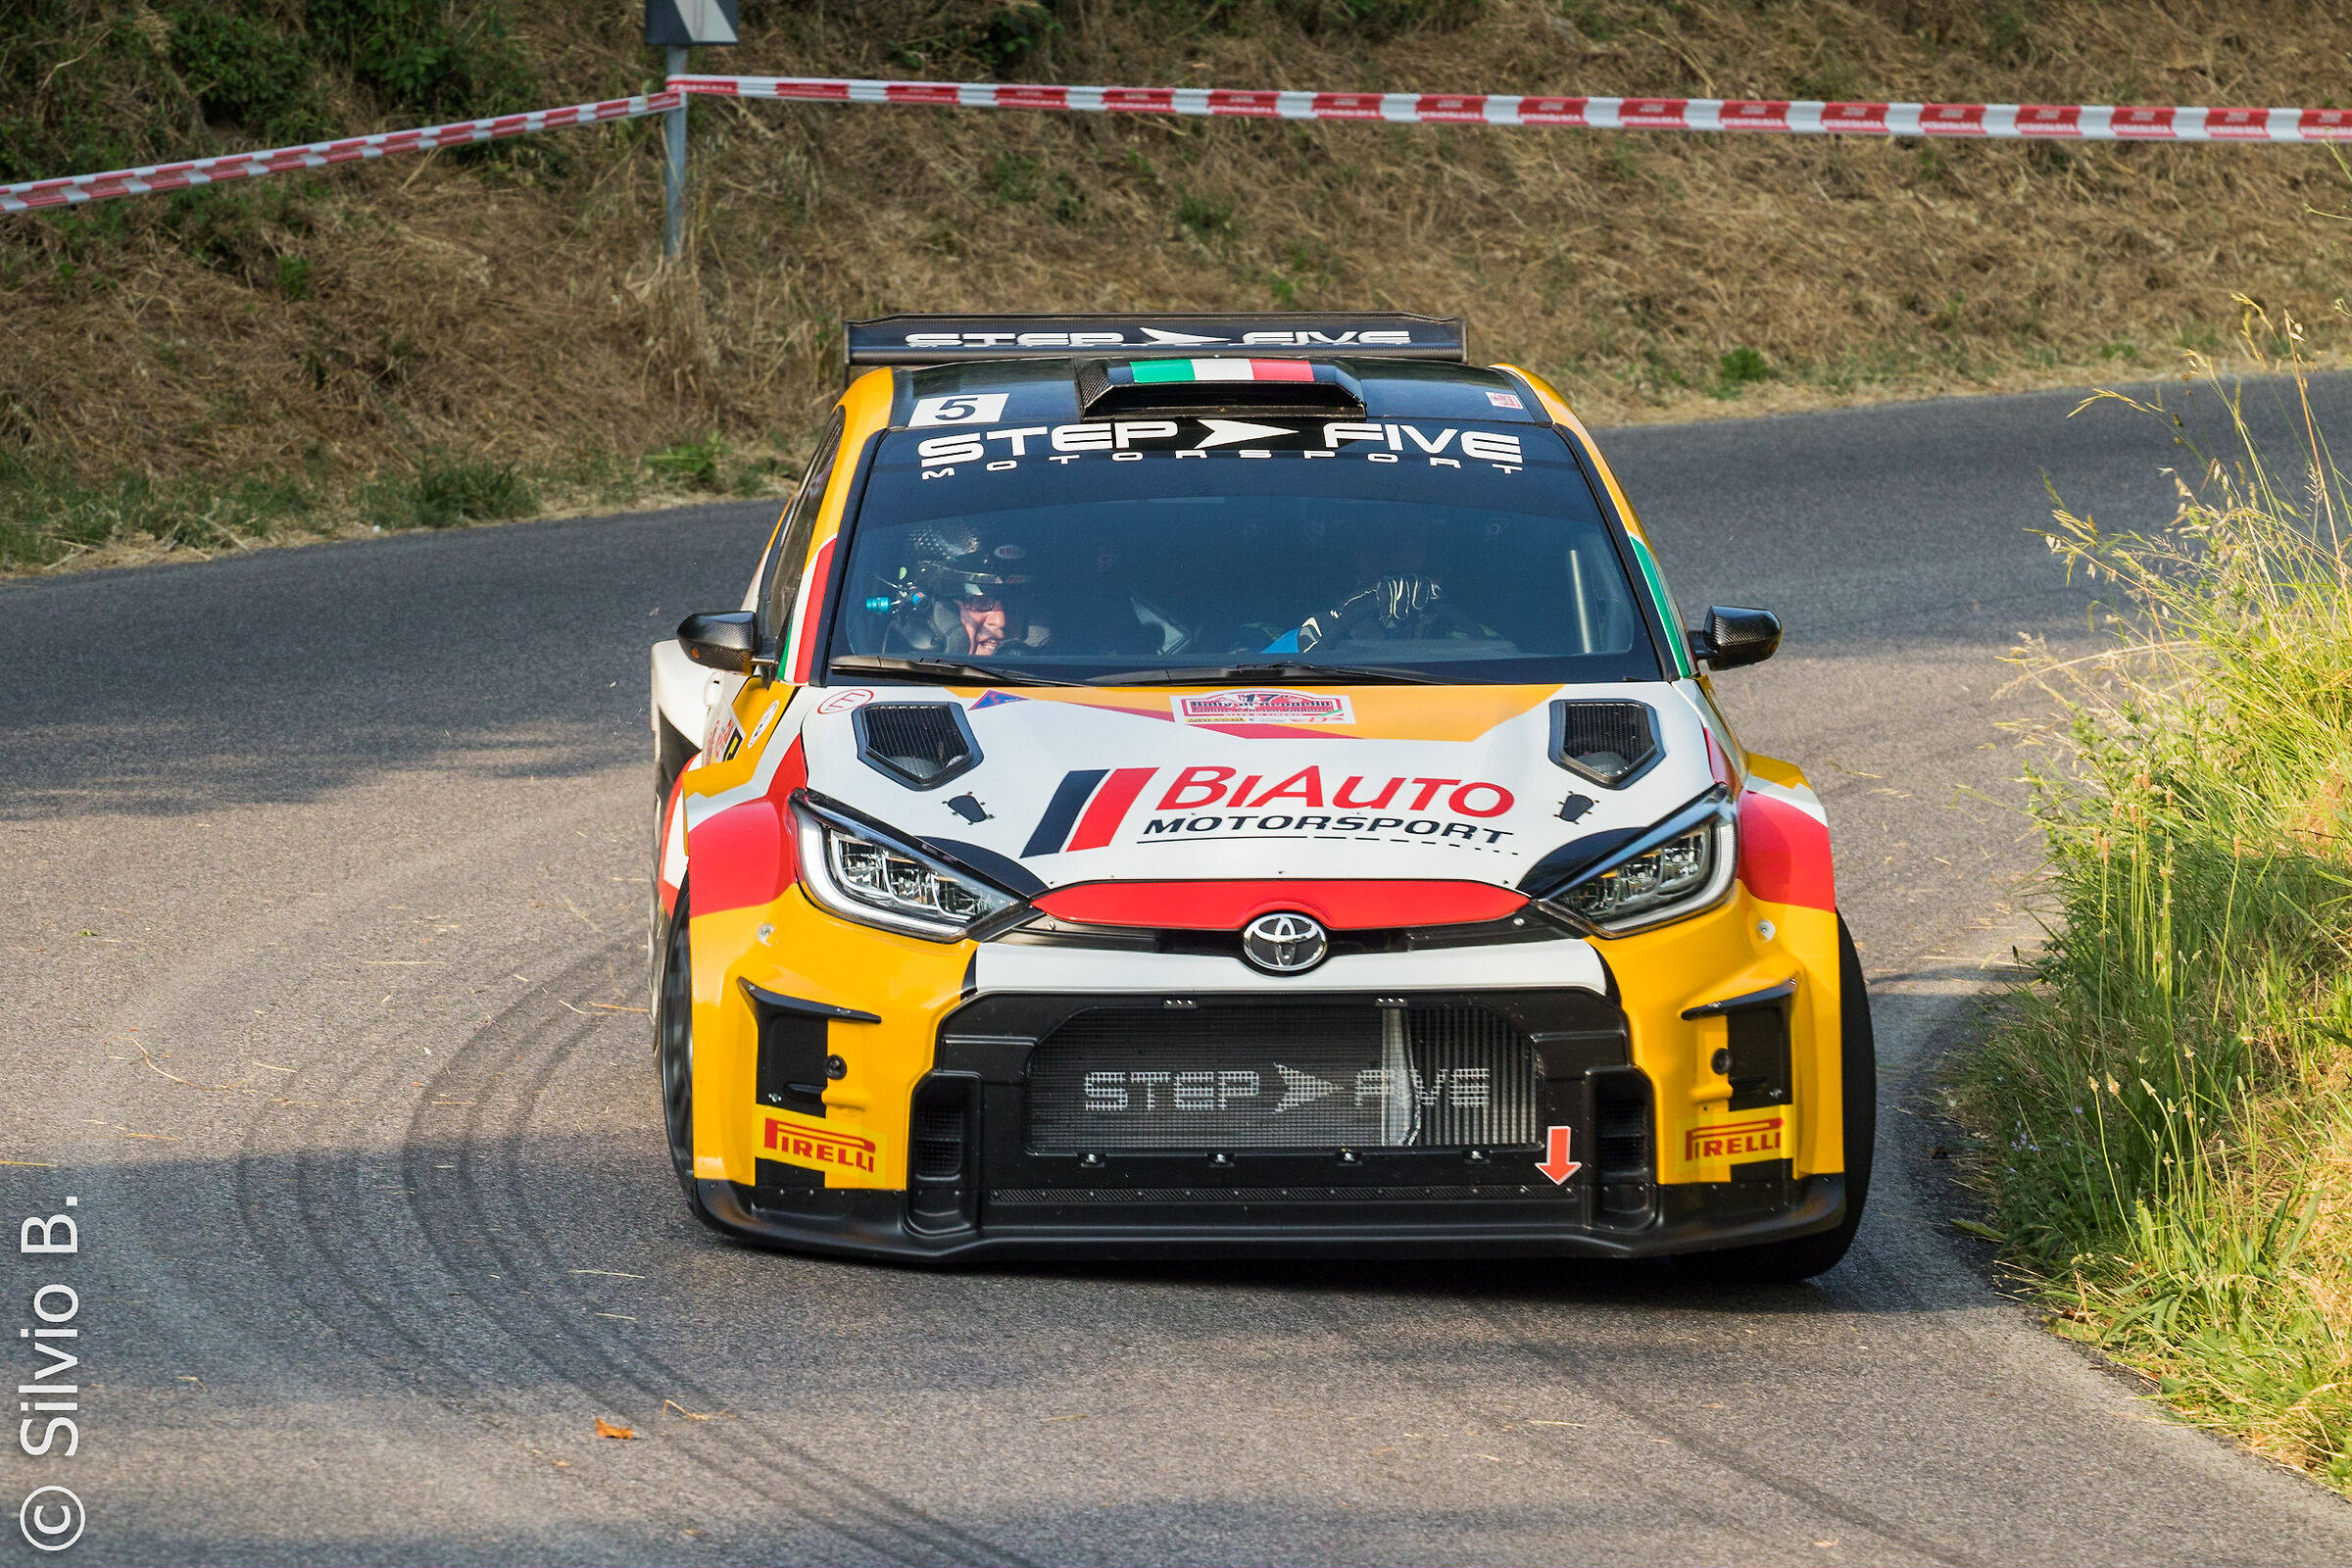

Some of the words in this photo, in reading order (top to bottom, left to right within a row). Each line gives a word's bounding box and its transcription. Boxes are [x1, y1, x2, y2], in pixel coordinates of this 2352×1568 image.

[905, 331, 1125, 347] STEP
[1242, 330, 1411, 346] FIVE
[934, 397, 979, 421] 5
[917, 420, 1178, 468] STEP
[1323, 422, 1523, 464] FIVE
[921, 448, 1523, 480] MOTORSPORT
[1155, 764, 1515, 818] BIAUTO
[1143, 814, 1513, 844] MOTORSPORT
[1084, 1069, 1260, 1111] STEP
[763, 1116, 876, 1174] PIRELLI
[1685, 1117, 1785, 1161] PIRELLI
